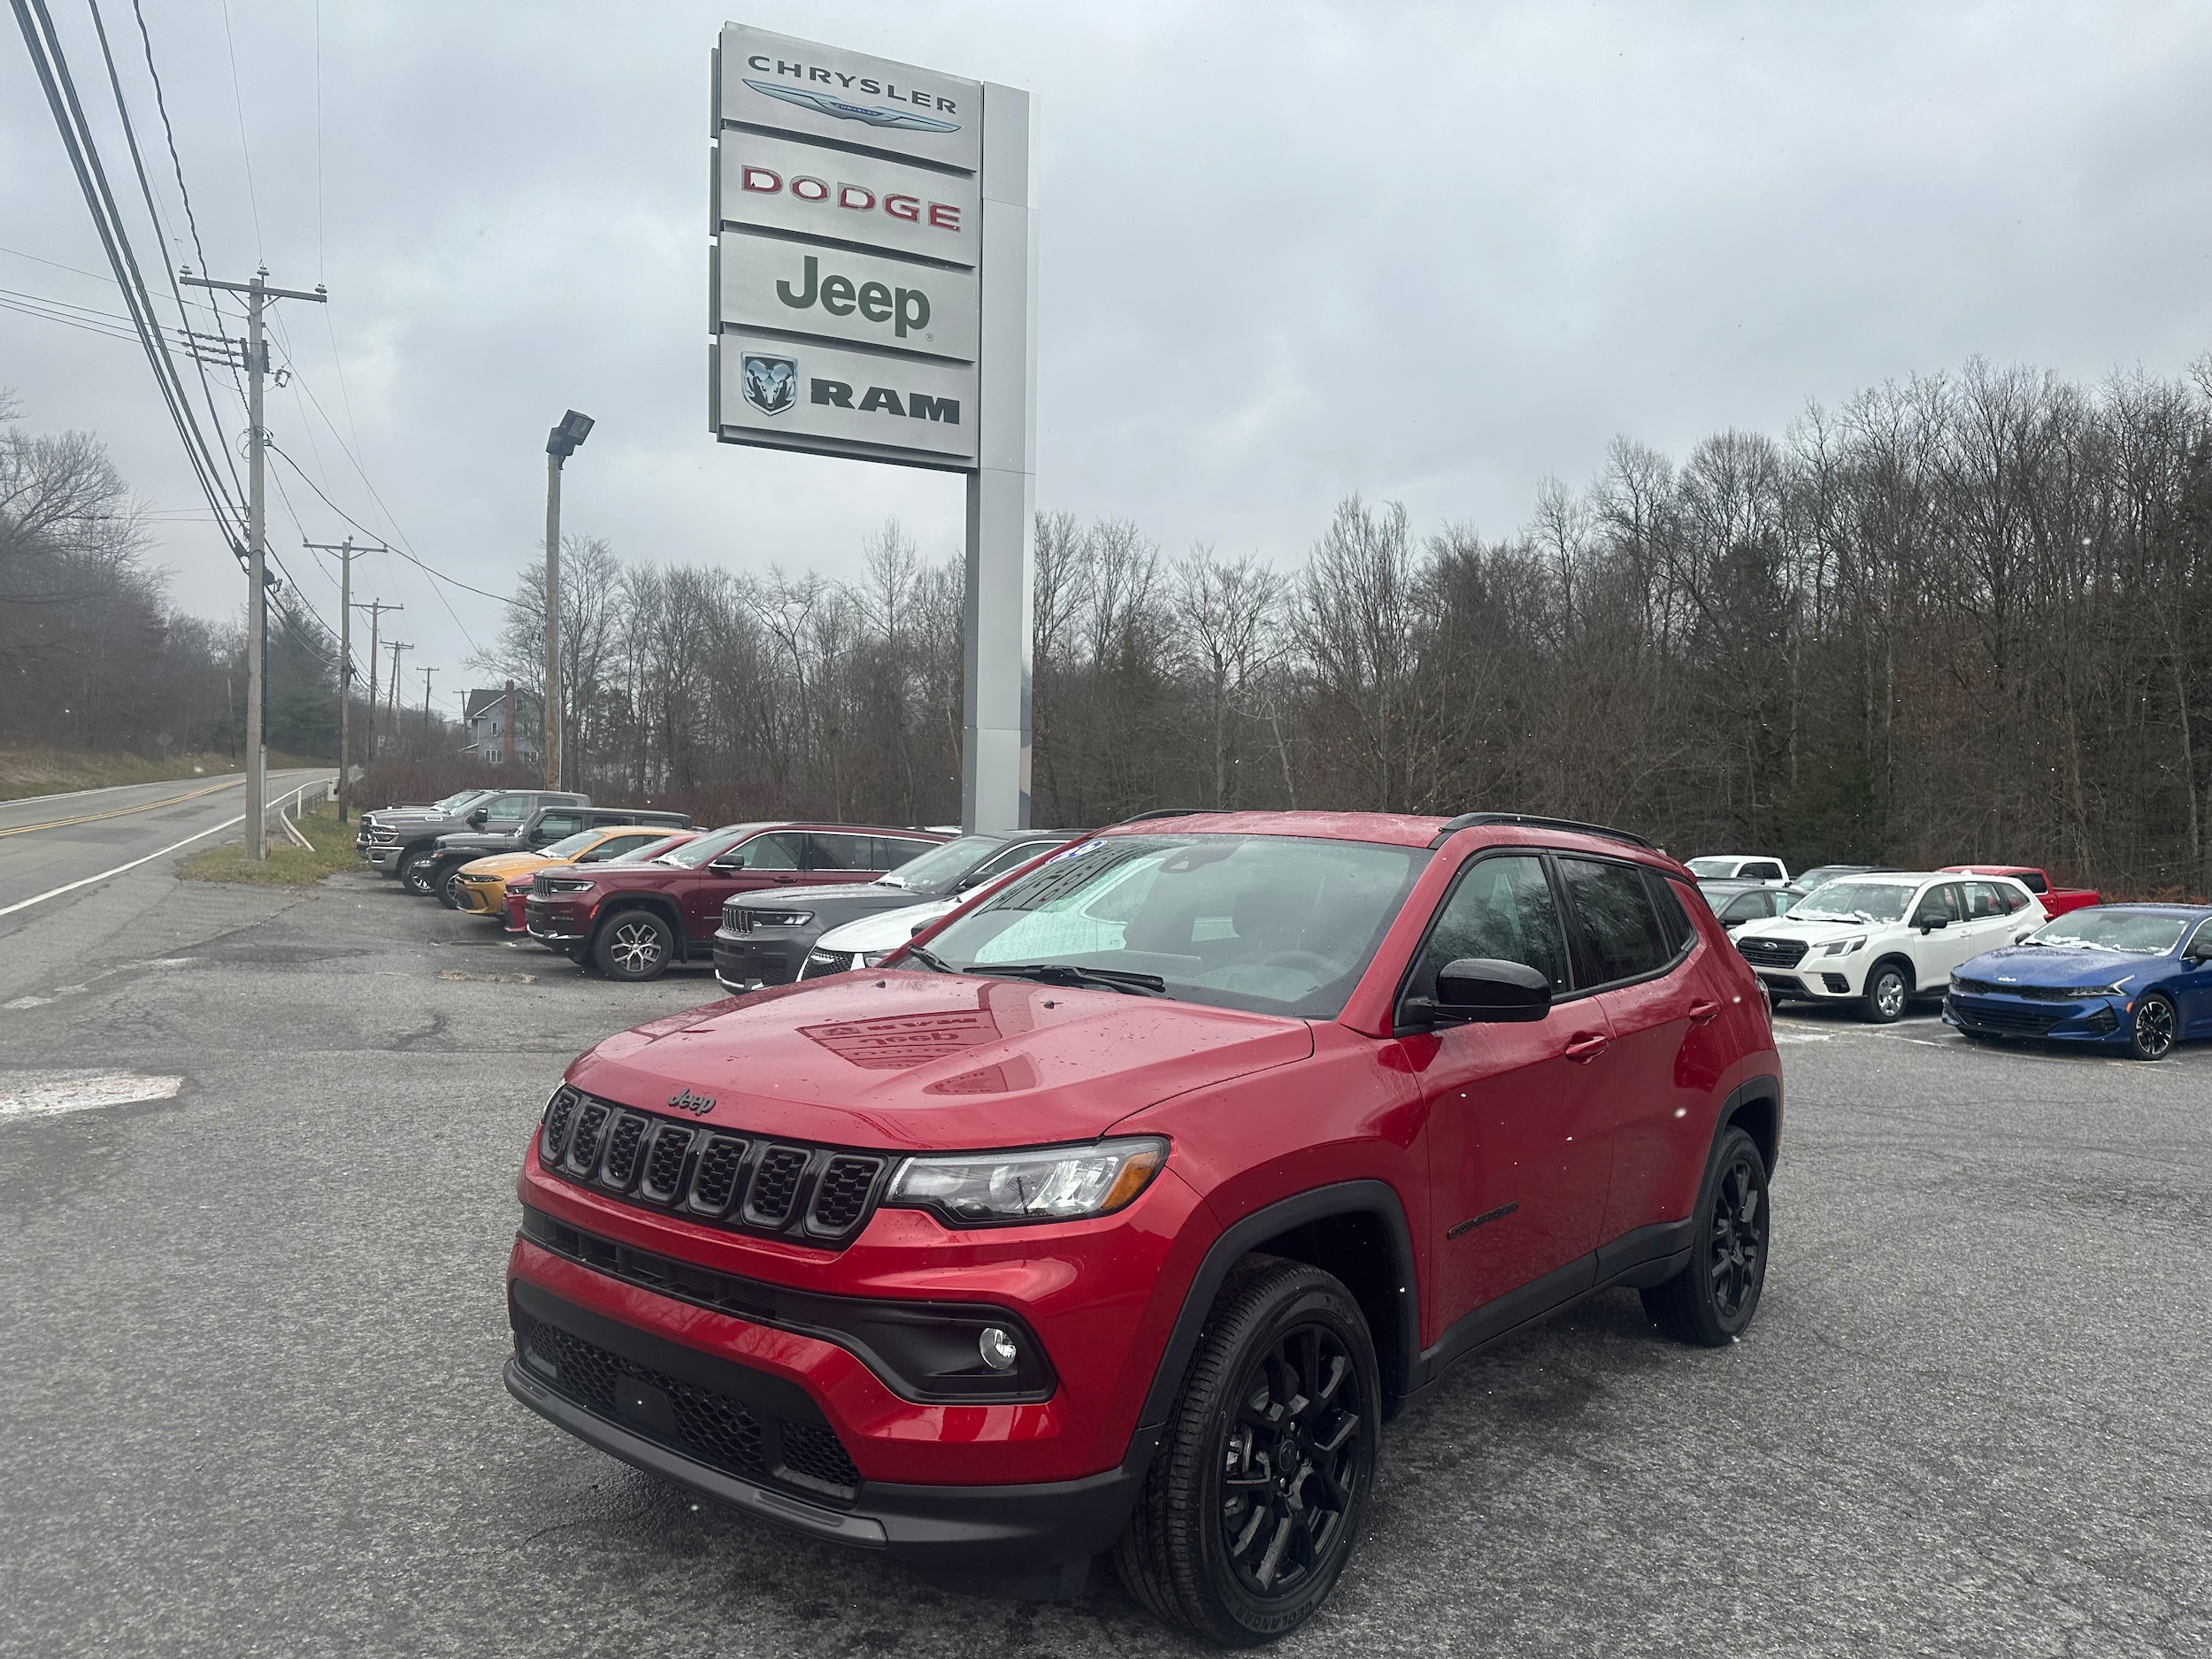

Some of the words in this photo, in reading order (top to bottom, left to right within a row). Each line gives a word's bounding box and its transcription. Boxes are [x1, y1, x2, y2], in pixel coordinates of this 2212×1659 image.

[748, 56, 957, 115] CHRYSLER
[741, 165, 962, 233] DODGE
[776, 255, 932, 338] Jeep
[810, 378, 961, 425] RAM
[667, 1087, 716, 1117] Jeep
